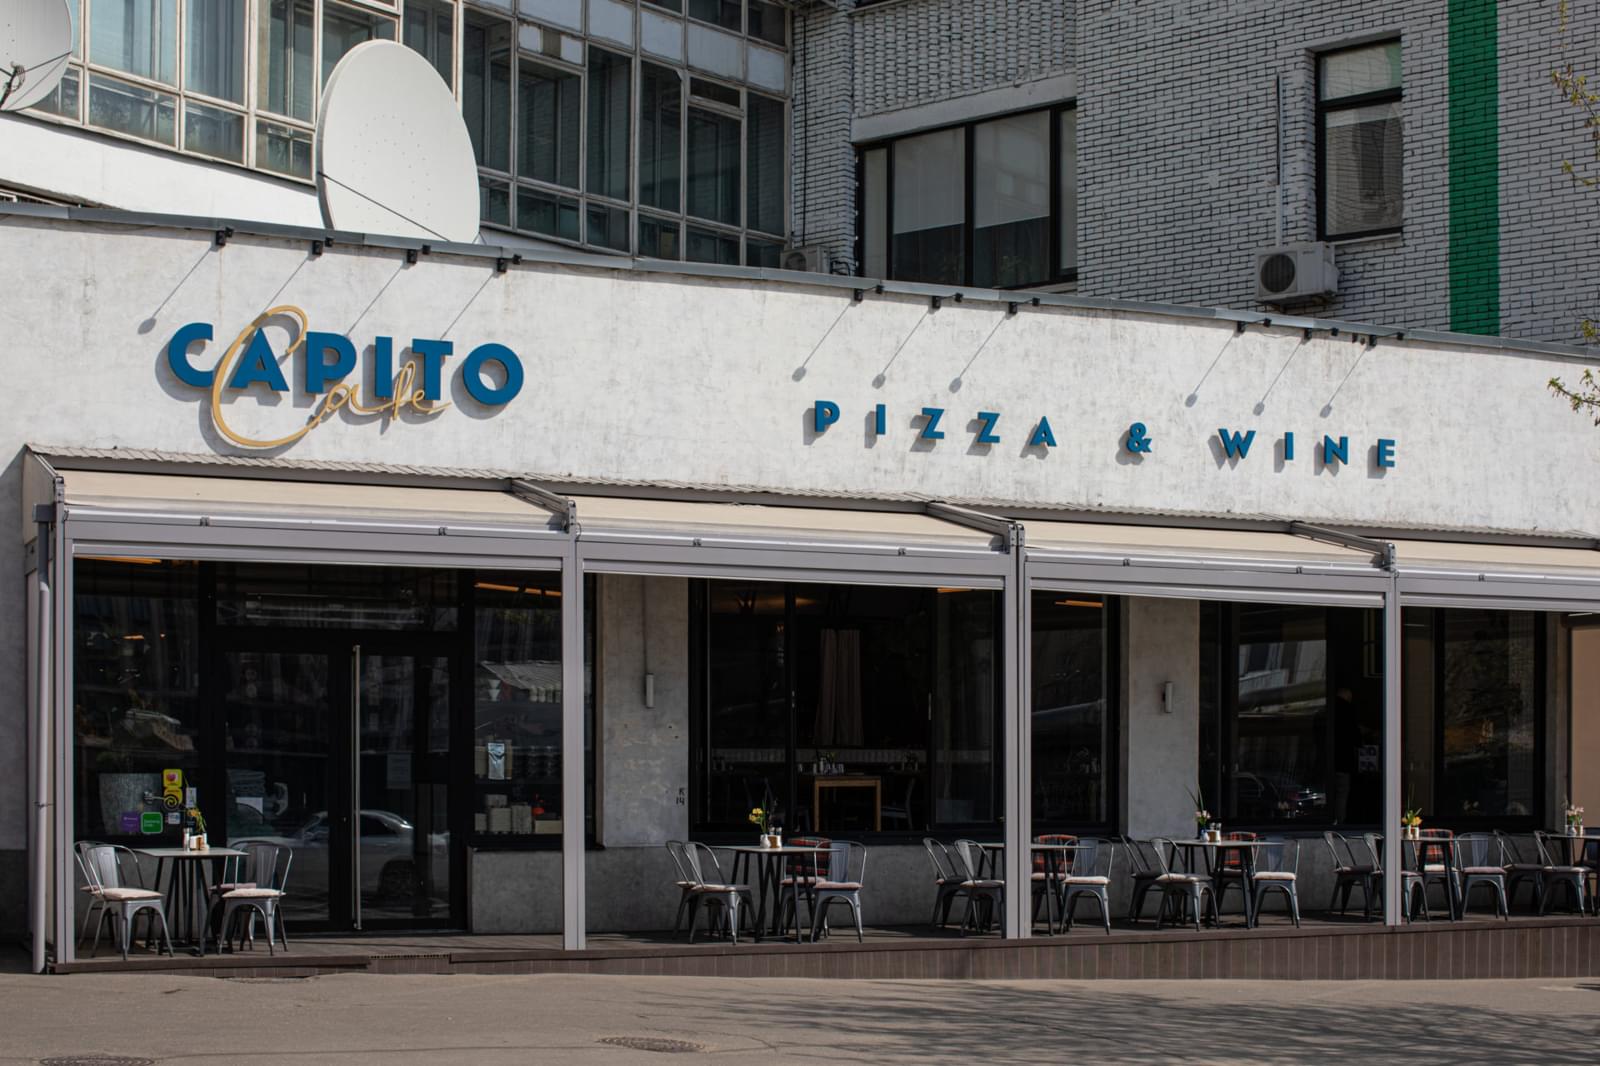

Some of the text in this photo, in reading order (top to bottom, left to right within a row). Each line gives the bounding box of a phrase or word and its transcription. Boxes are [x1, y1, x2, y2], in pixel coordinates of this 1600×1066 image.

[168, 322, 524, 405] CAPITO
[211, 305, 452, 447] Cafe
[814, 400, 1396, 467] PIZZA & WINE
